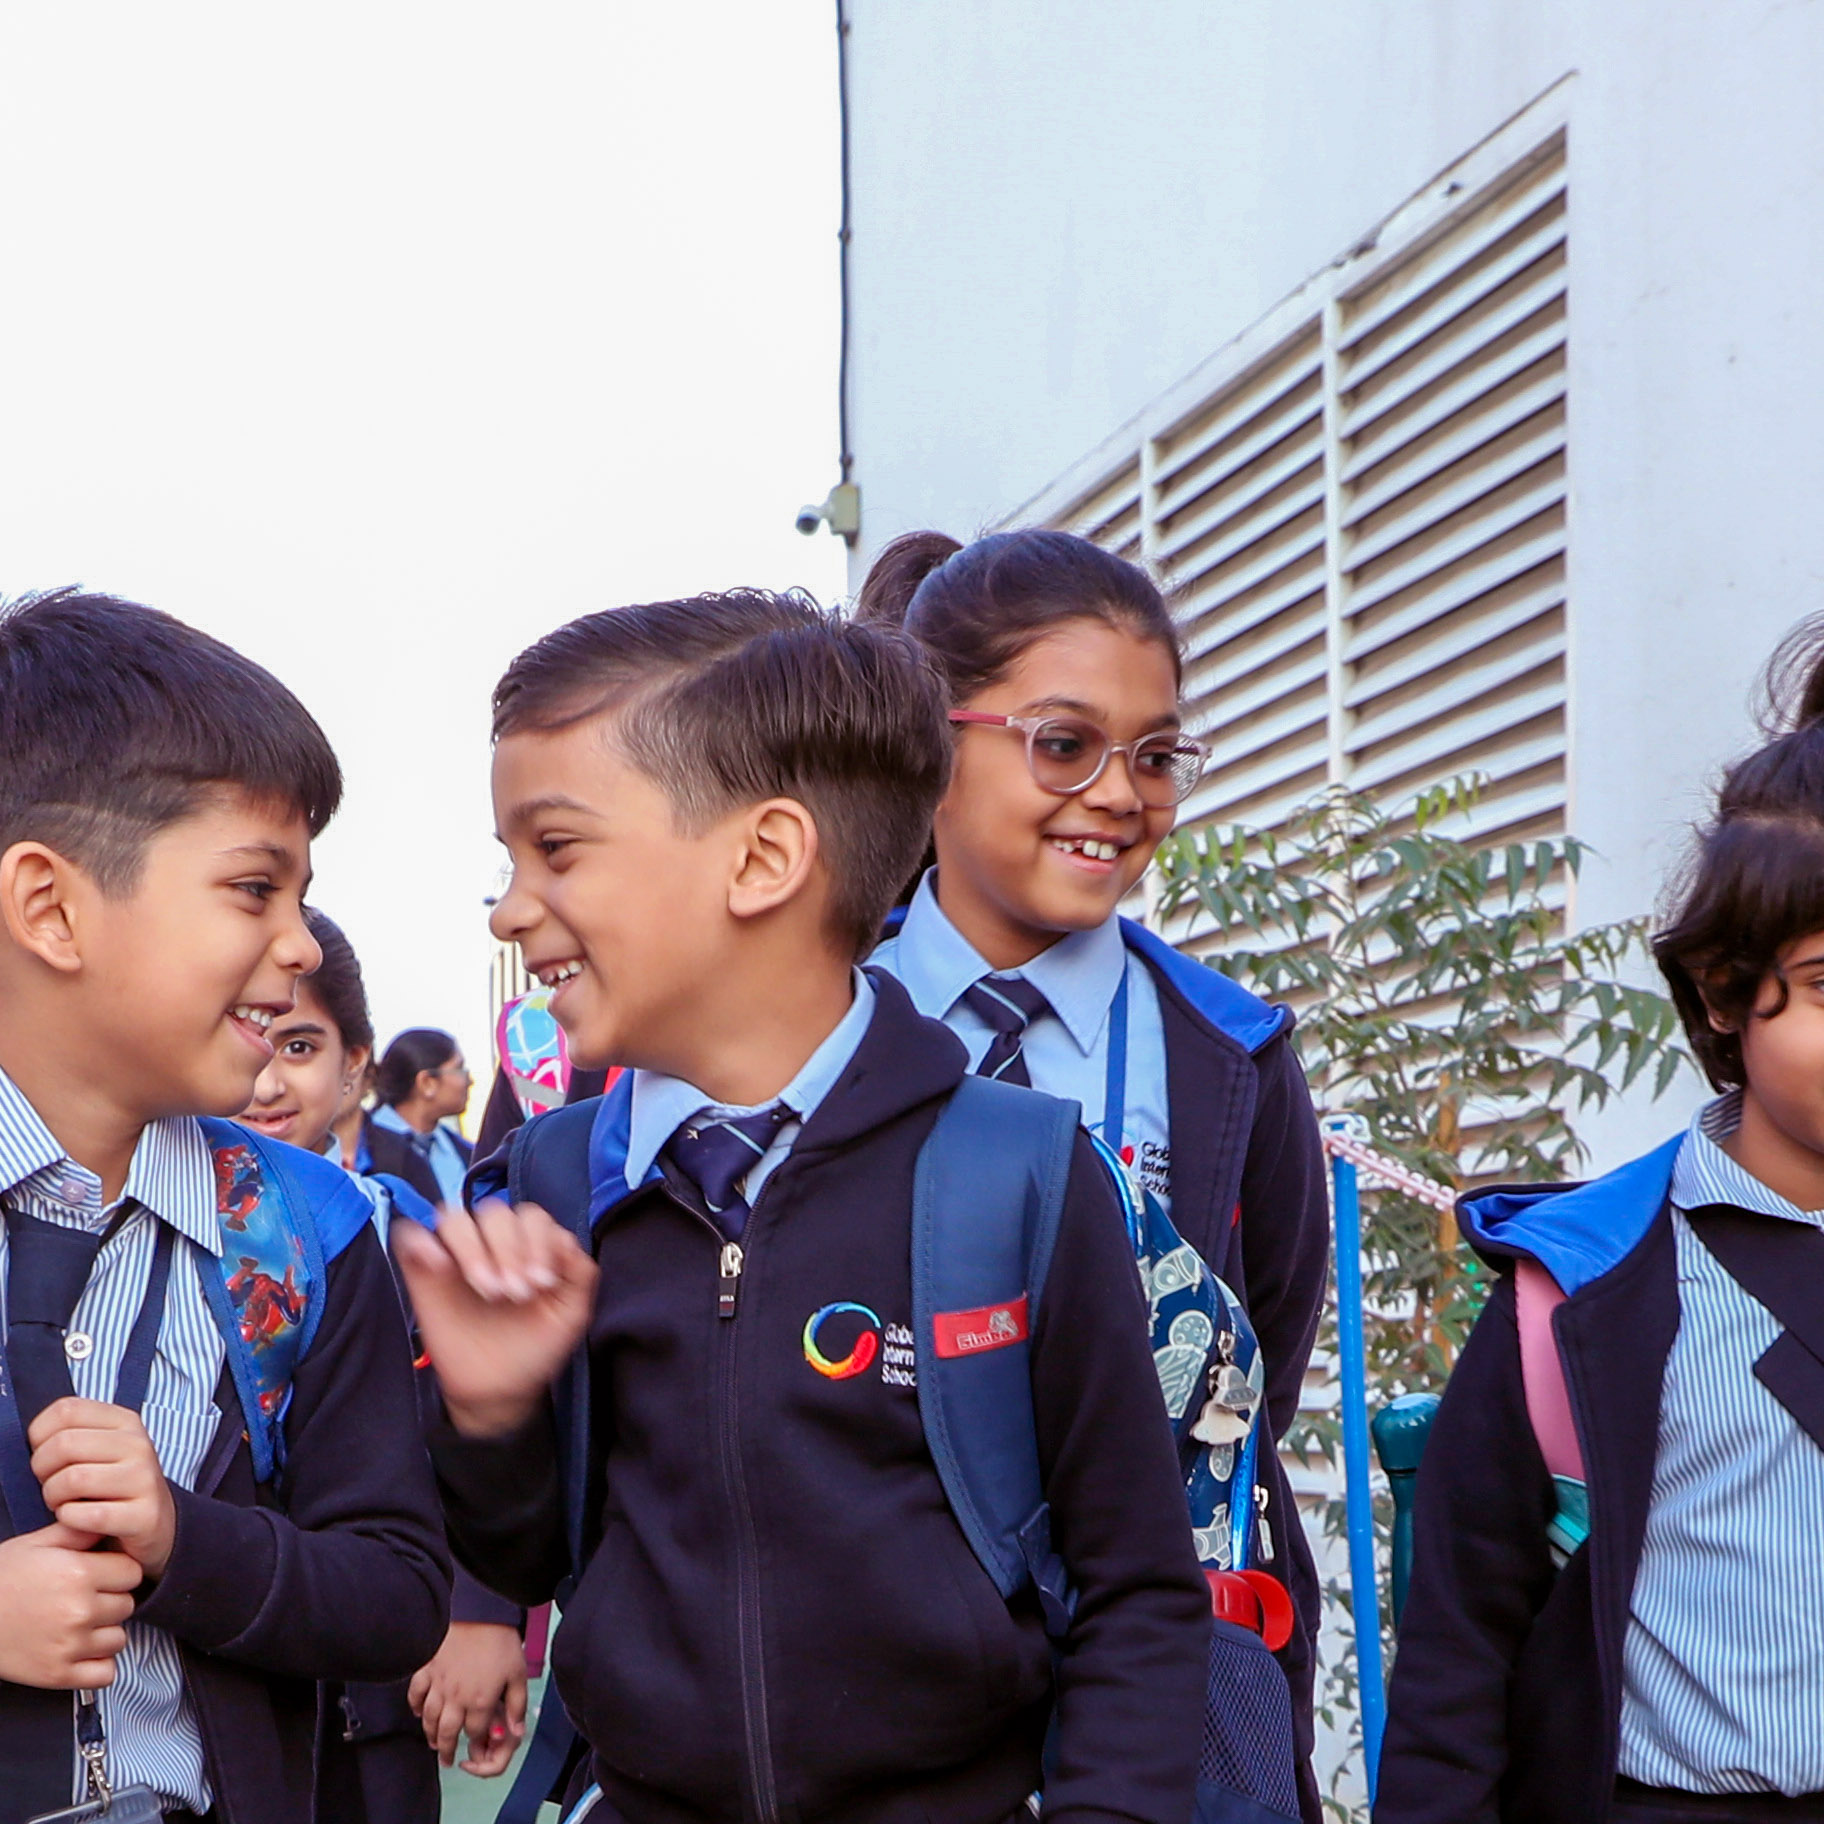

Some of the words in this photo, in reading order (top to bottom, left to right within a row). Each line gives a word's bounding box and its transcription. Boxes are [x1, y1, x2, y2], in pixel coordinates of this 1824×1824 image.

[1142, 1141, 1170, 1160] Glob
[1140, 1156, 1170, 1178] Intern
[885, 1323, 914, 1345] Glob
[883, 1342, 915, 1366] Intern
[882, 1364, 917, 1386] Schoo
